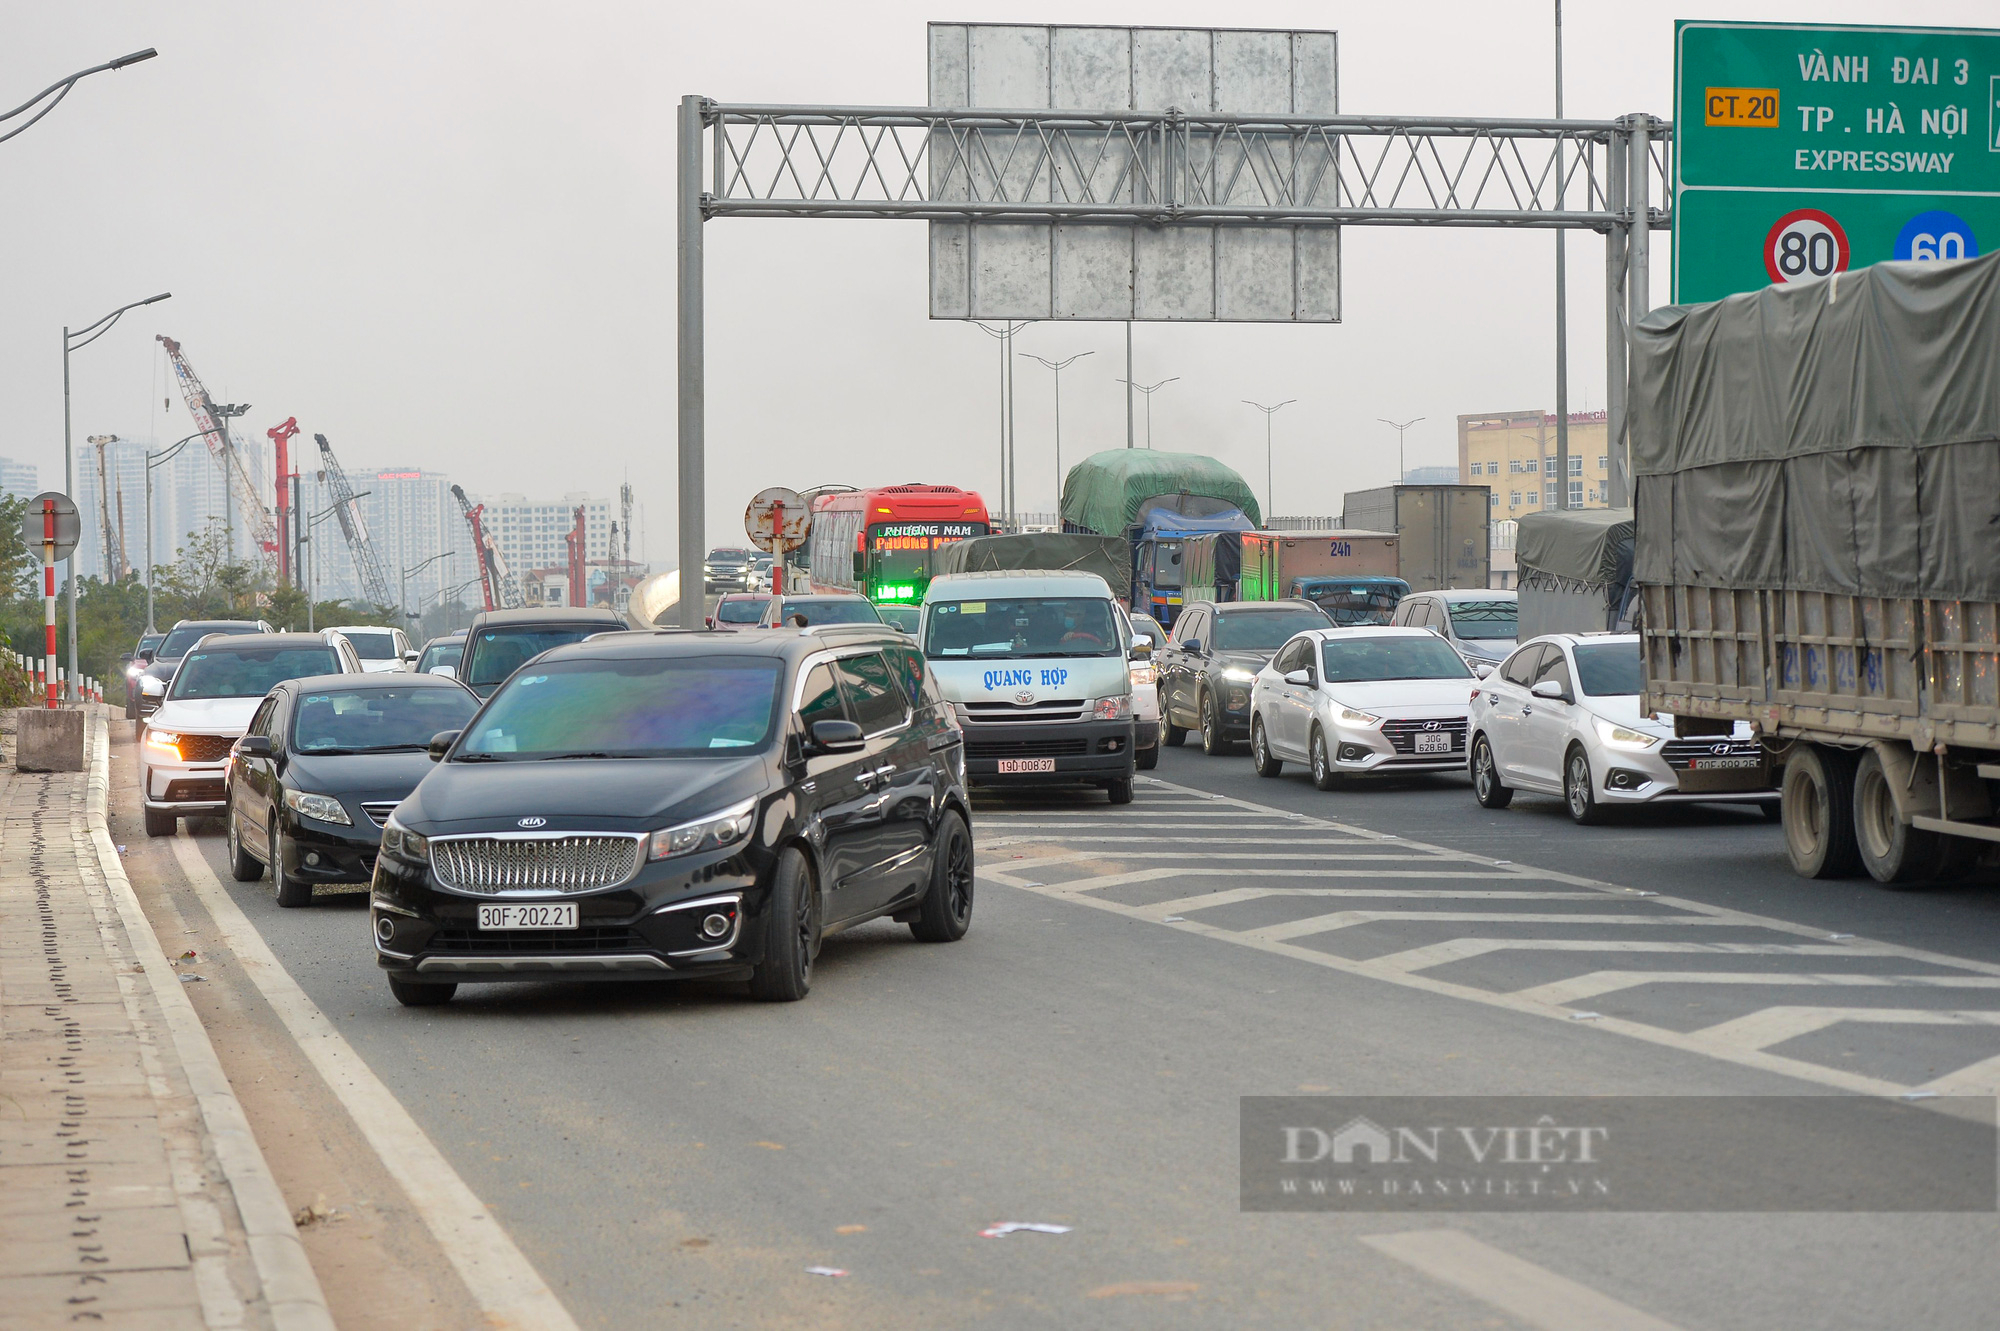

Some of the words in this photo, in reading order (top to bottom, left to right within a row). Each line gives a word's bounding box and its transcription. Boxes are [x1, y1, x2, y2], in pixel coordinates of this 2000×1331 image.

[1798, 48, 1869, 83] VÀNH
[1891, 57, 1939, 85] ĐAI
[1954, 59, 1969, 86] 3
[1708, 95, 1777, 119] CT.20
[1866, 102, 1906, 134] HÀ
[1921, 104, 1968, 139] NỘI
[1795, 149, 1955, 173] EXPRESSWAY
[1780, 231, 1834, 277] 80
[1911, 232, 1965, 261] 60
[943, 525, 972, 536] NAM
[1330, 541, 1351, 557] 24h
[983, 669, 1032, 691] QUANG
[1040, 667, 1068, 690] HỢP
[1418, 743, 1448, 752] 628.60
[1424, 734, 1442, 743] 30G
[521, 817, 541, 826] KIA
[481, 906, 573, 927] 30F-202.21
